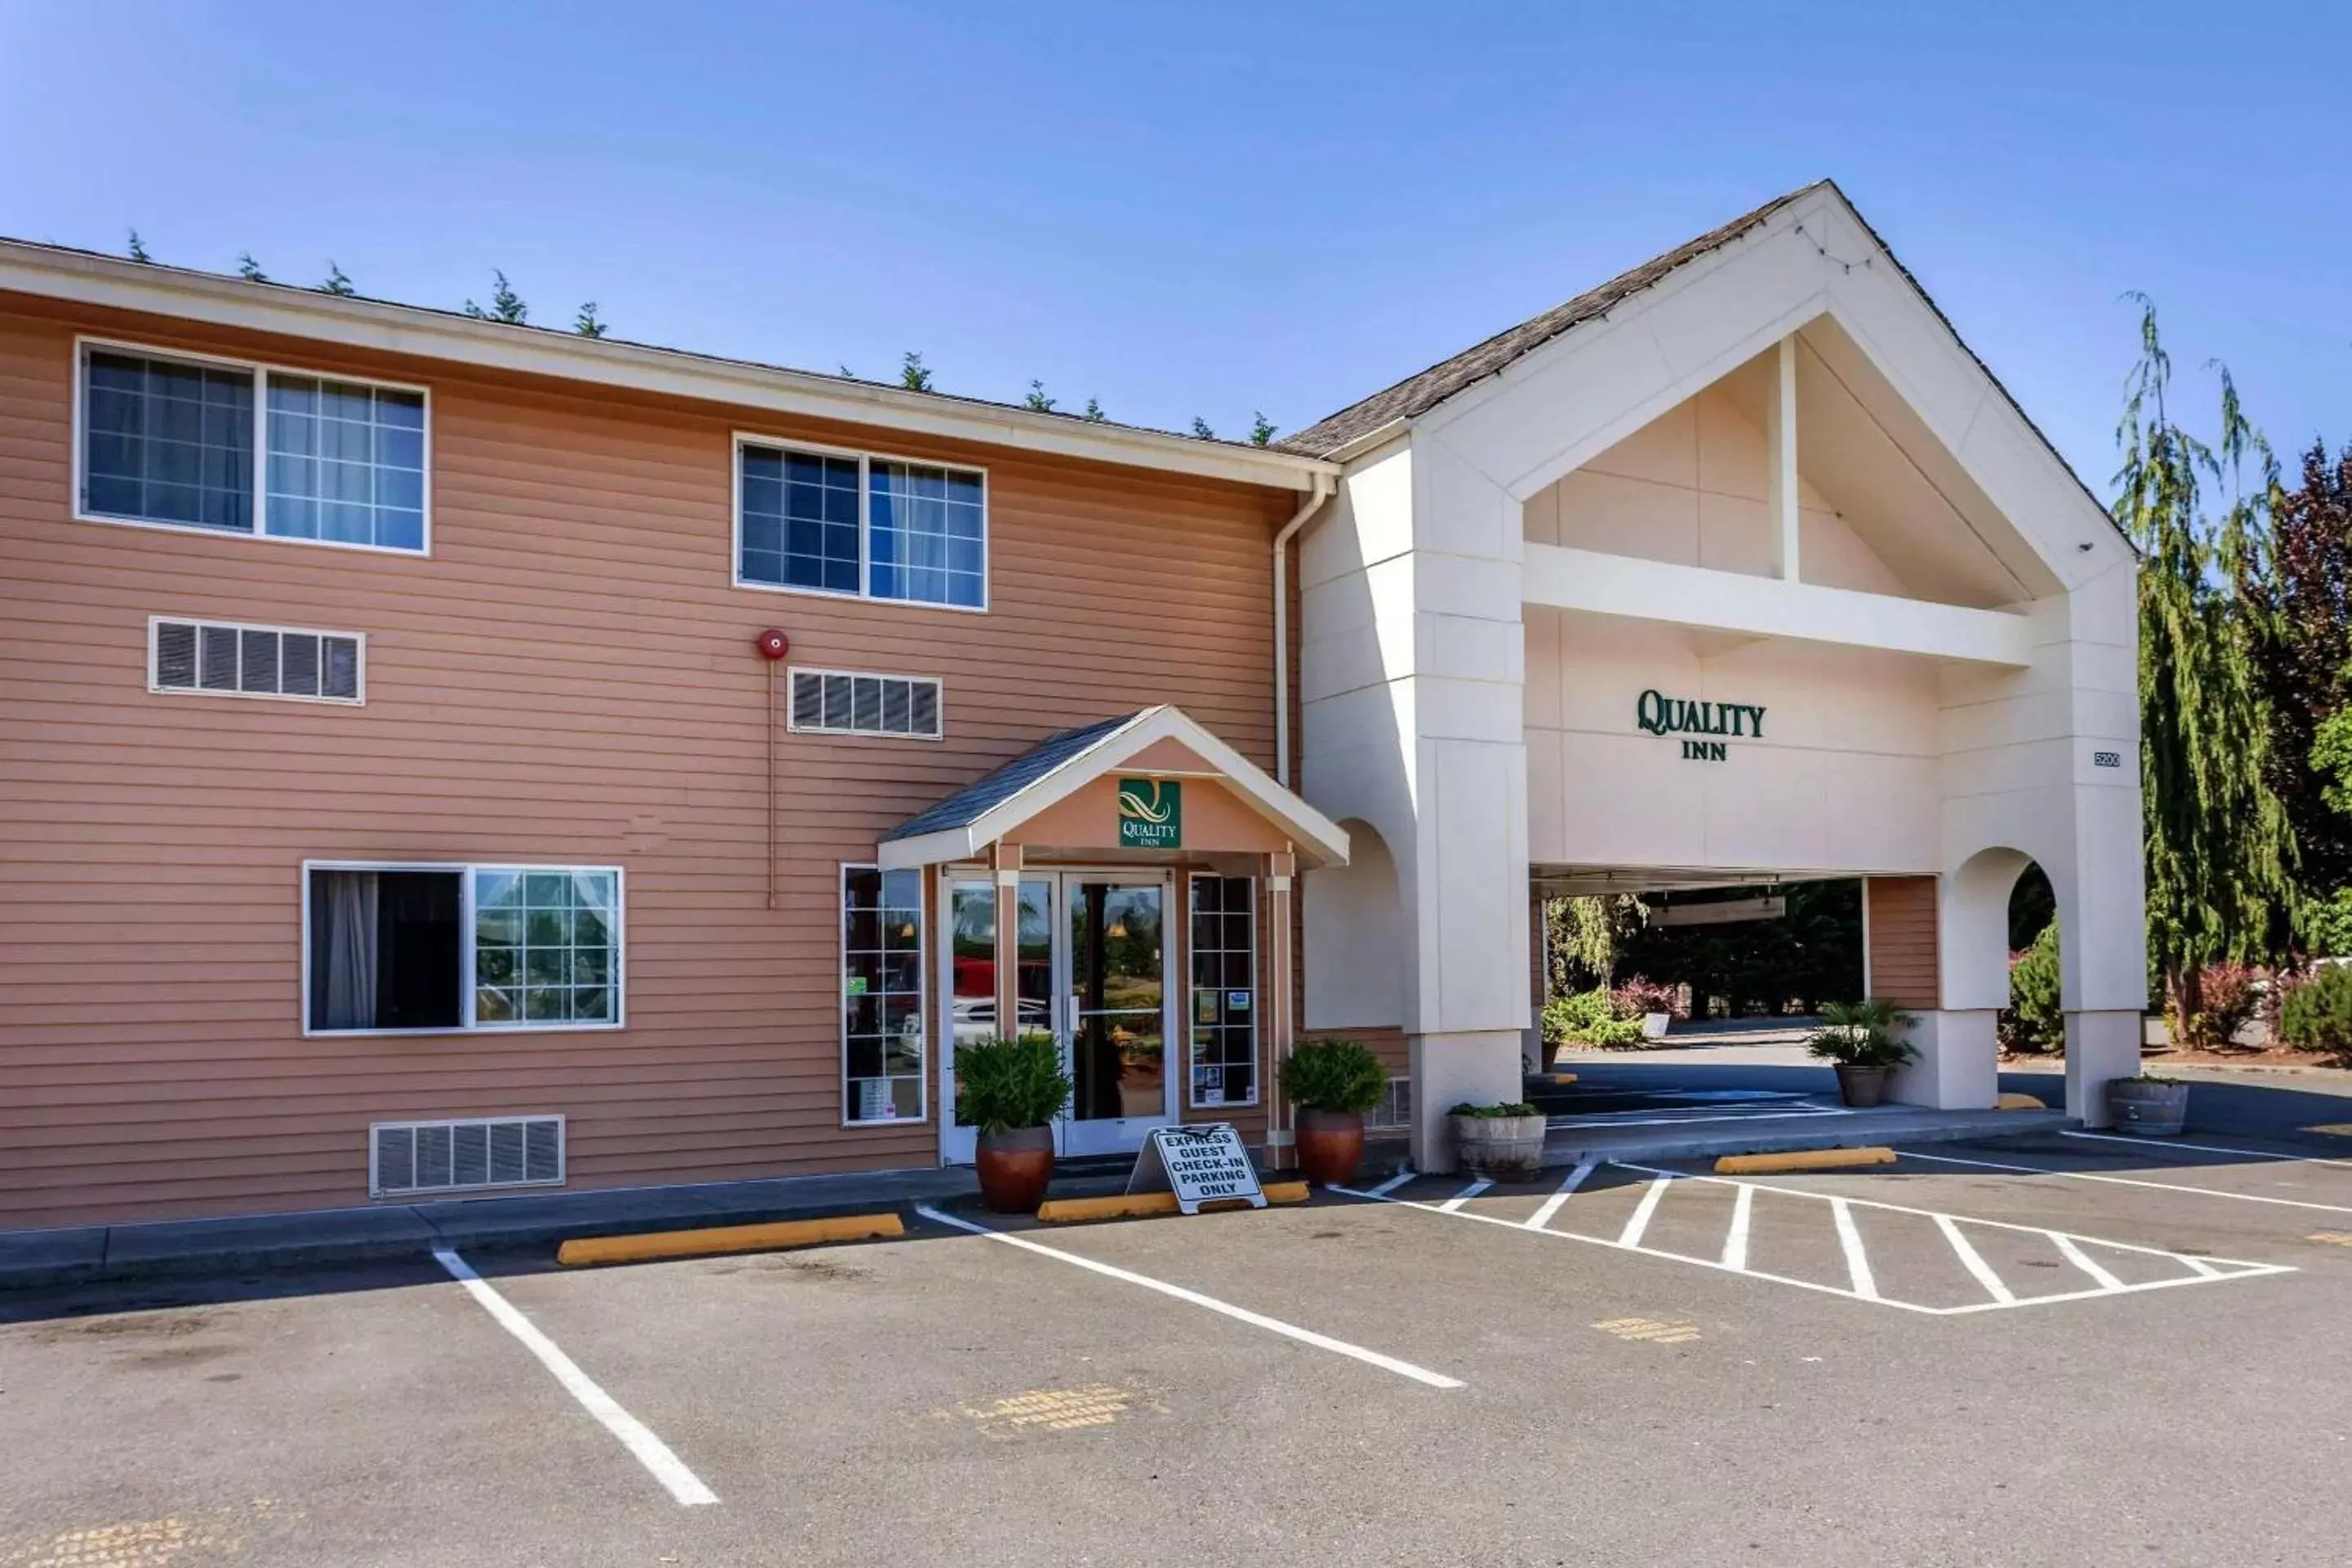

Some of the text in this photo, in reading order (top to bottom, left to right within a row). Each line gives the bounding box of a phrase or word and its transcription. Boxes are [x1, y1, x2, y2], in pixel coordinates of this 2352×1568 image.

[1638, 689, 1766, 737] QUALITY
[1682, 741, 1726, 761] INN
[1123, 821, 1176, 838] QUALITY
[1141, 838, 1160, 846] INN
[1165, 1134, 1232, 1147] EXPRESS
[1180, 1146, 1227, 1158] GUEST
[1172, 1157, 1245, 1172] CHECK-IN
[1180, 1169, 1246, 1184] PARKING
[1200, 1183, 1236, 1196] ONLY
